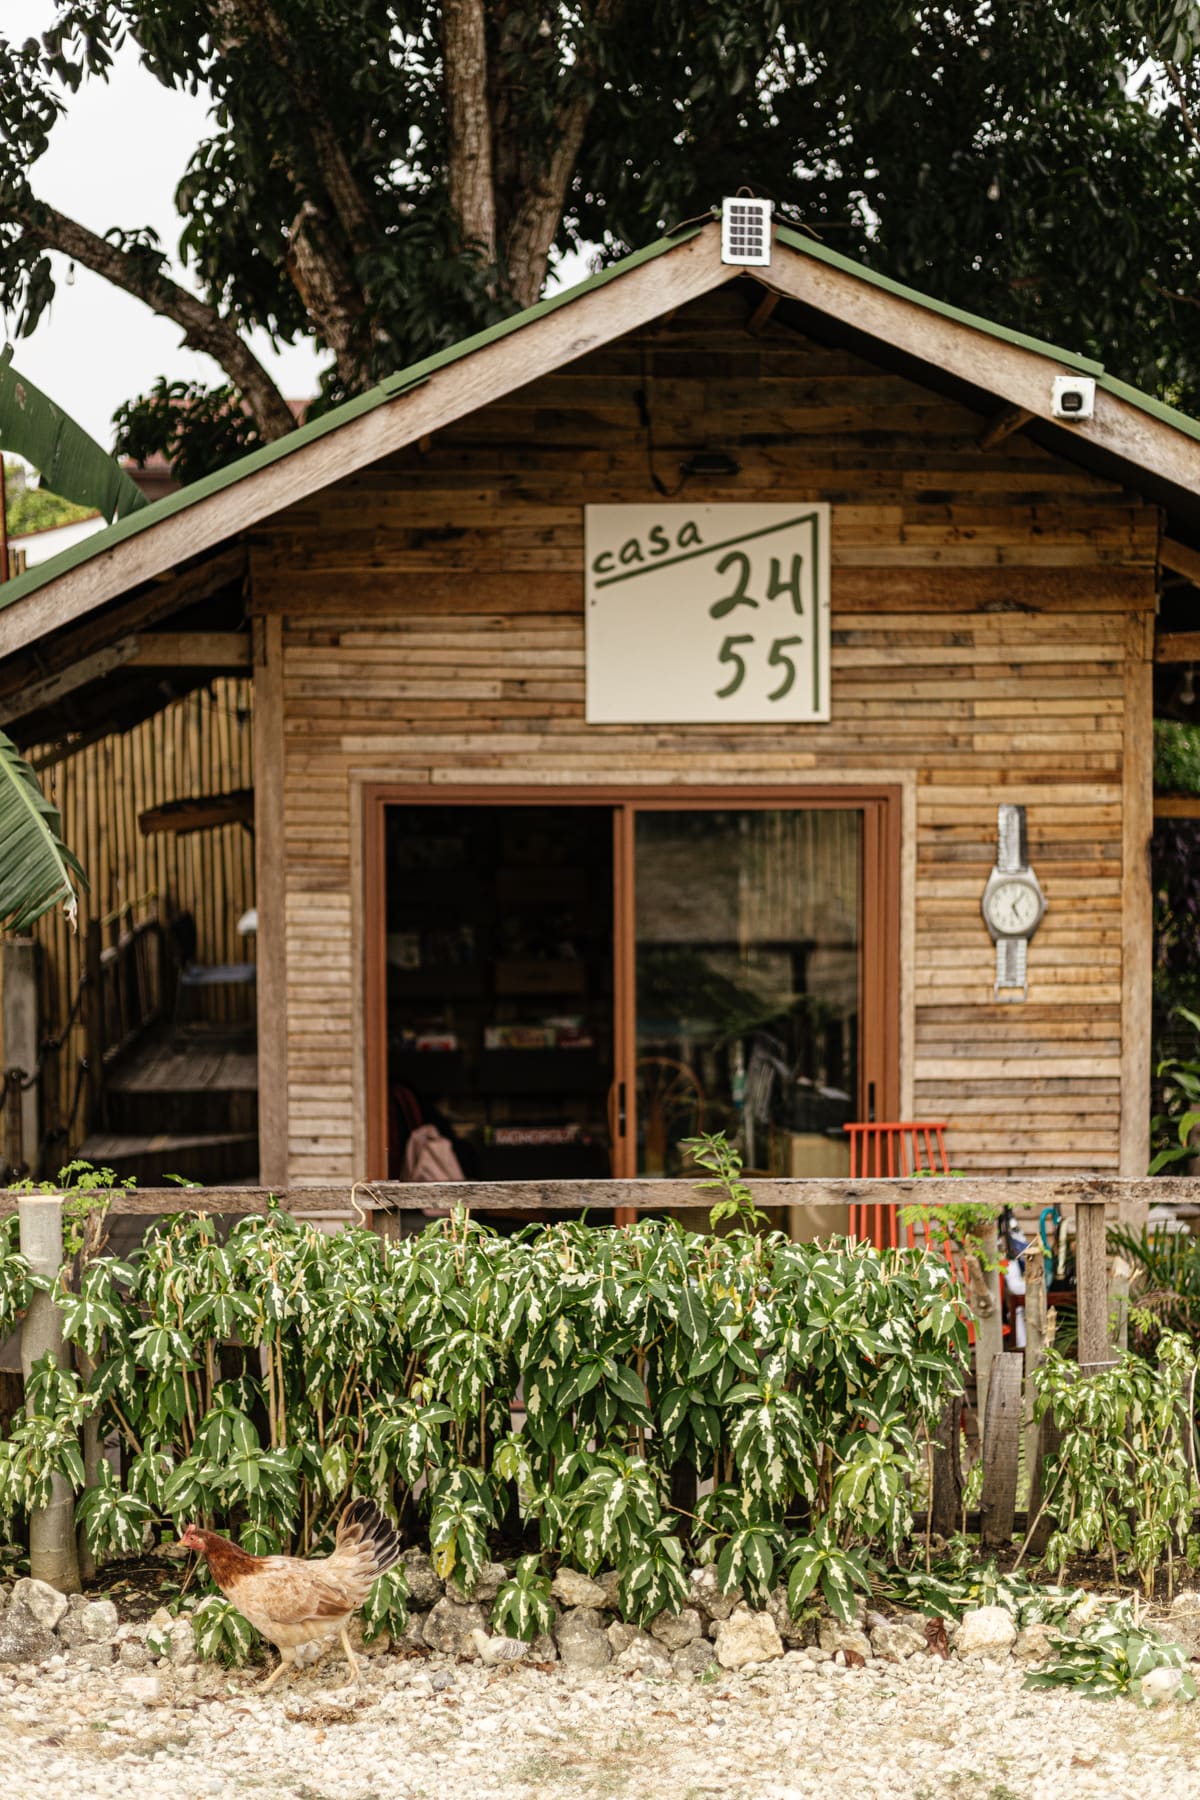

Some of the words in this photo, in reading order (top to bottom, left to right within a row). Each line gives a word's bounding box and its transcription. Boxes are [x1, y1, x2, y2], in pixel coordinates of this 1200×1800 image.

[592, 520, 704, 575] casa
[709, 551, 804, 620] 24
[715, 634, 803, 701] 55
